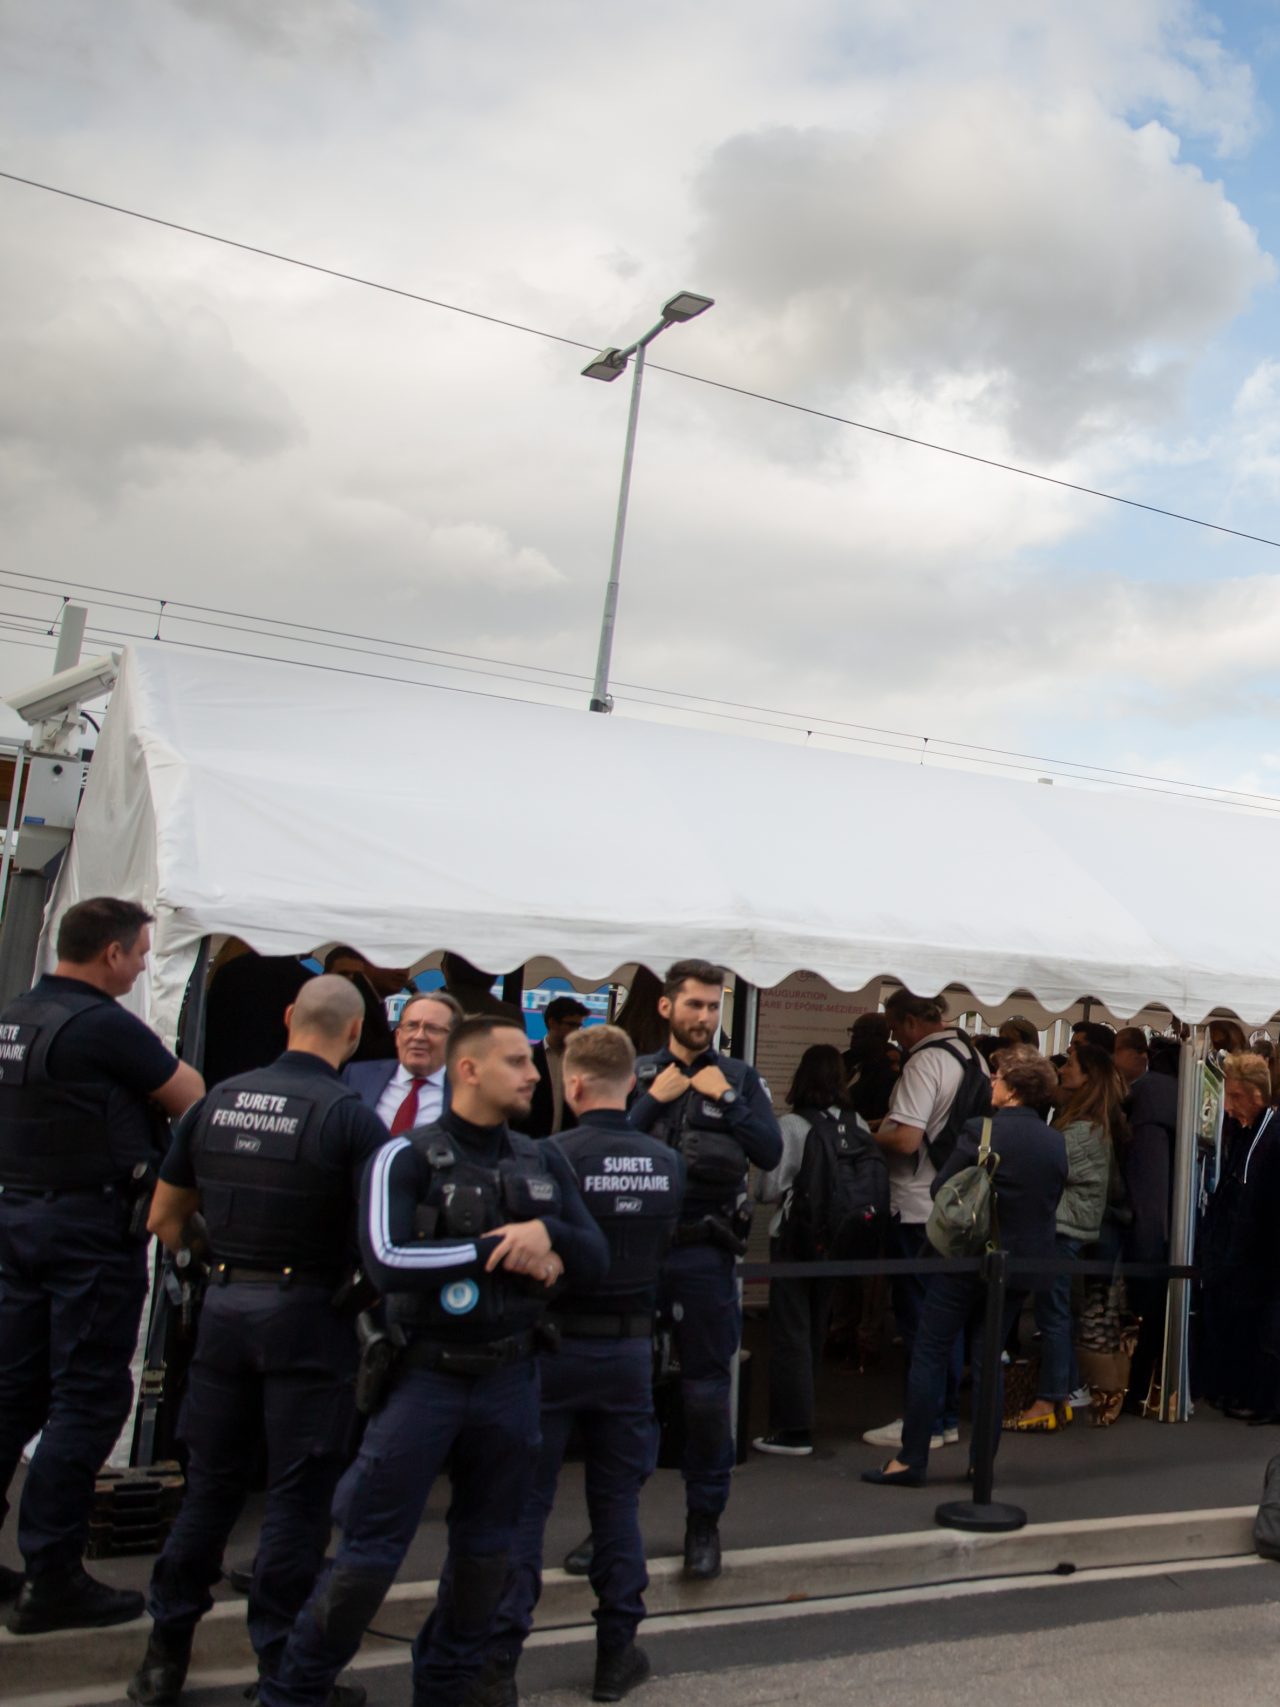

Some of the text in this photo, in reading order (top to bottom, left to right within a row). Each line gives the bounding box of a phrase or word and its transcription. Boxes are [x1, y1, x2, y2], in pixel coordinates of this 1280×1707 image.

[760, 988, 828, 1001] NAUGURATION
[235, 1092, 287, 1113] SURETE
[212, 1109, 298, 1134] FERROVIAIRE
[603, 1156, 653, 1173] SURETE
[584, 1175, 670, 1192] FERROVIAIRE
